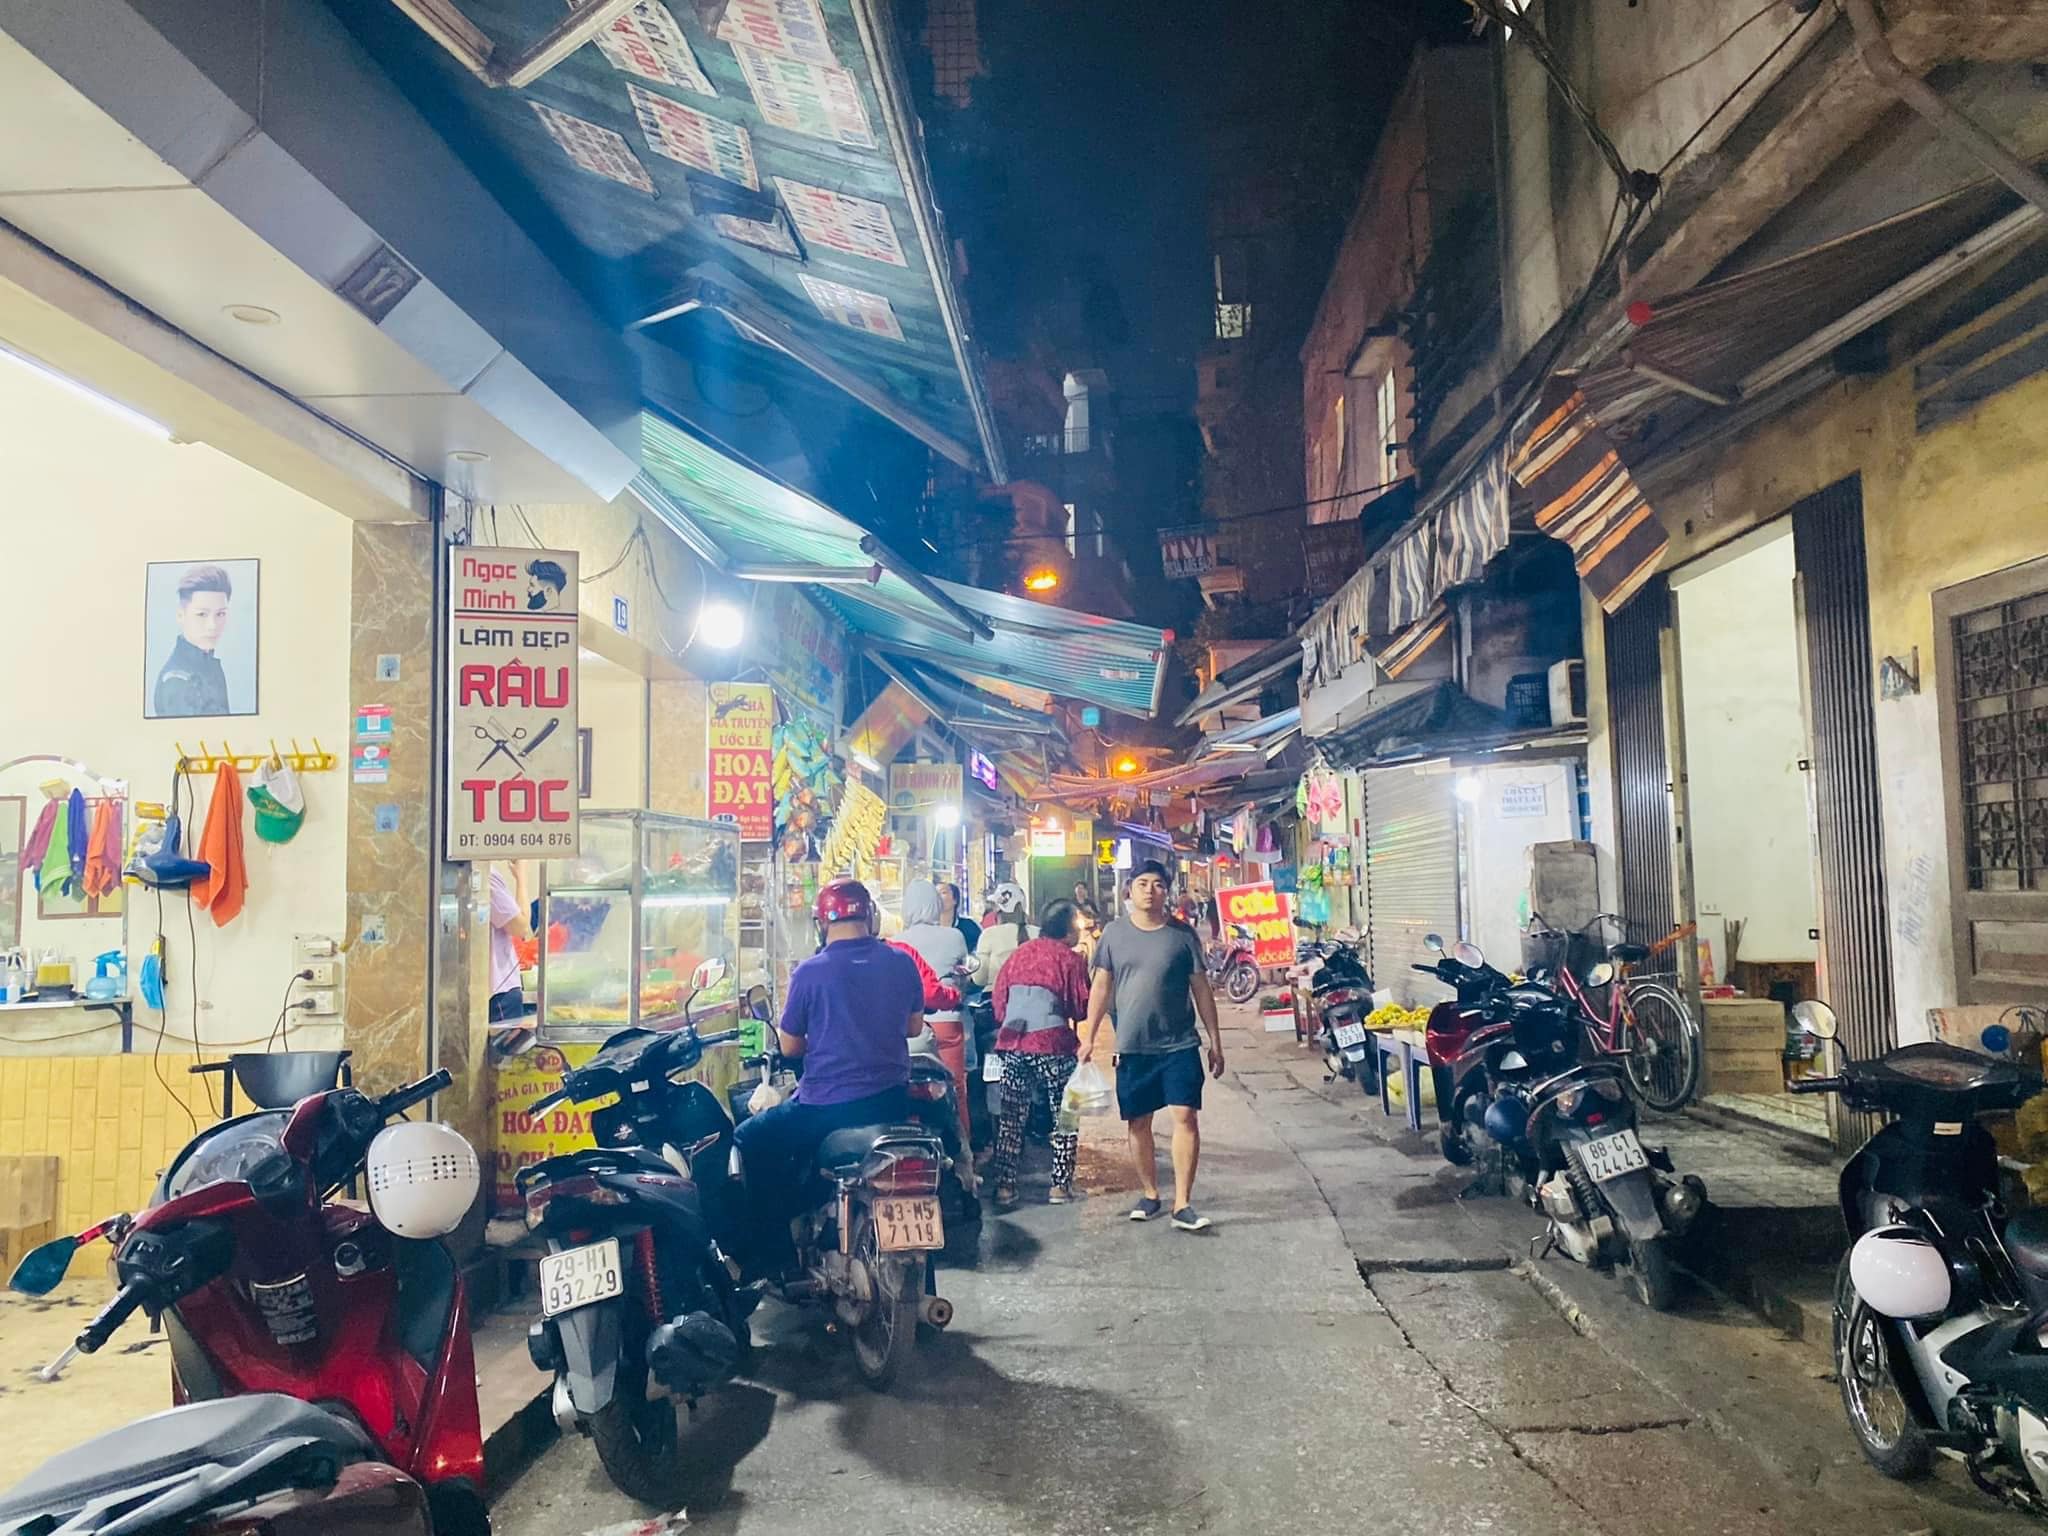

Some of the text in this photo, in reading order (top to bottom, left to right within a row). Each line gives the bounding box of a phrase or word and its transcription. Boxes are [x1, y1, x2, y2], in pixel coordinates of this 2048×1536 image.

[462, 557, 516, 583] Ngọc
[463, 587, 516, 610] Minh
[617, 601, 626, 627] 19
[460, 624, 570, 652] LÀM ĐẸP
[459, 657, 569, 708] RÂU
[714, 753, 769, 777] HOA
[461, 771, 570, 823] TÓC
[713, 780, 771, 810] ĐẠT
[459, 833, 571, 847] ĐT: 0904 604 876
[888, 1222, 934, 1244] 7119
[554, 1245, 607, 1283] 29-H1
[550, 1269, 617, 1310] 932.29
